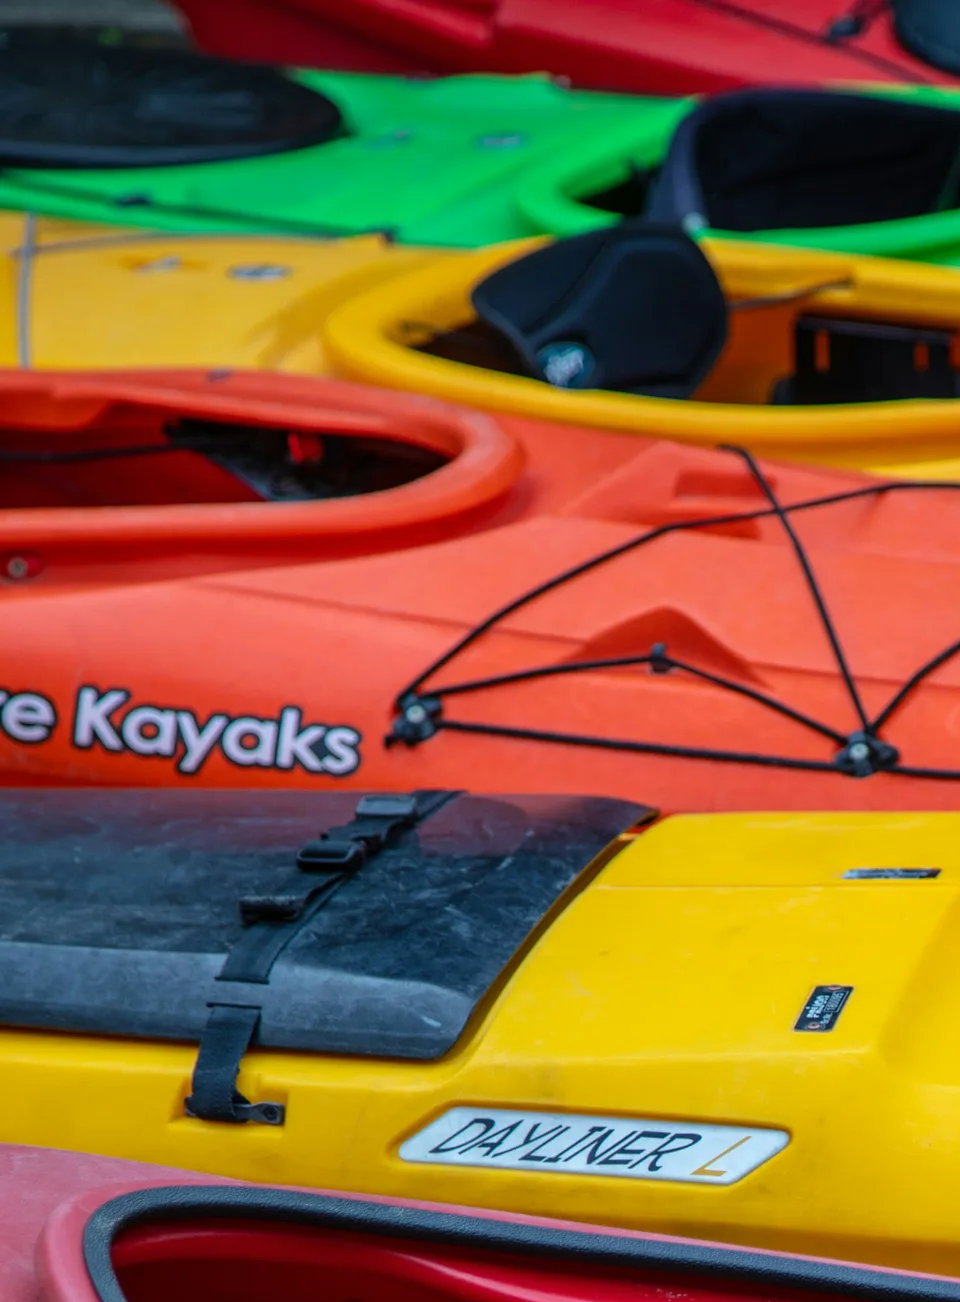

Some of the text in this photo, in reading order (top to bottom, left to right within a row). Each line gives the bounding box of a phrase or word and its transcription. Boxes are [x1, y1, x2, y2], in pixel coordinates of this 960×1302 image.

[0, 685, 362, 775] e Kayaks
[428, 1117, 753, 1177] DAYLINER L
